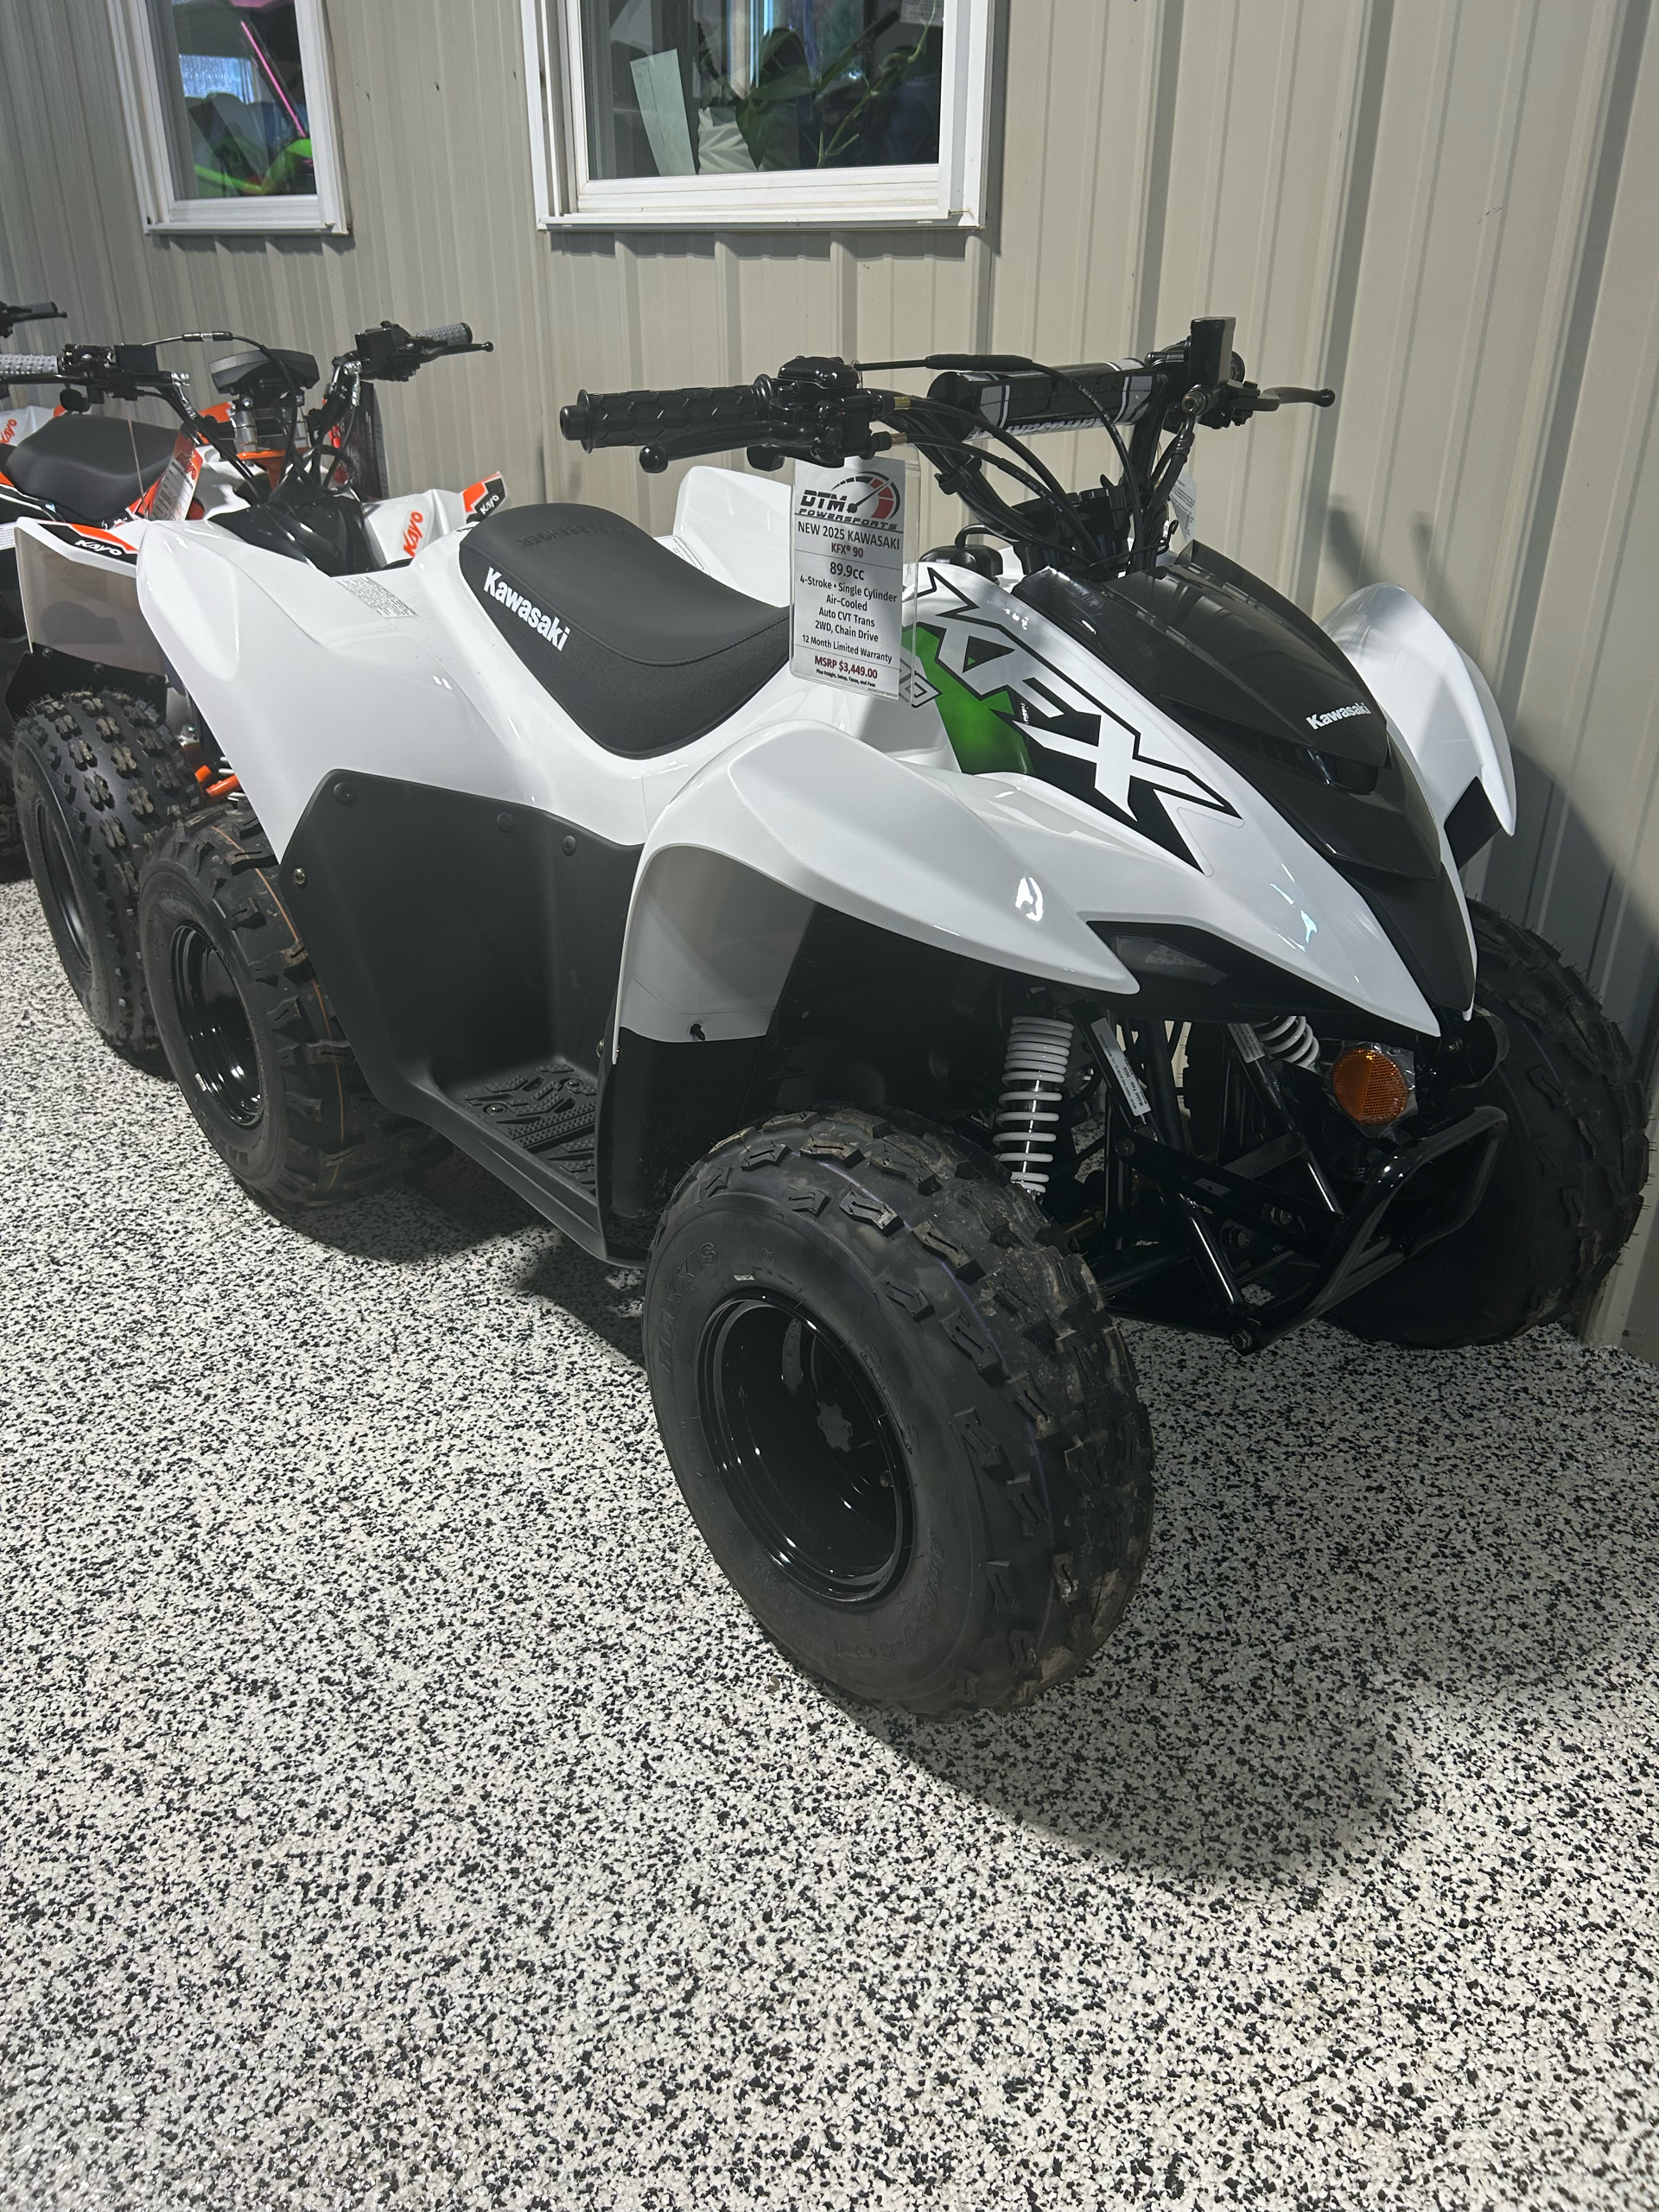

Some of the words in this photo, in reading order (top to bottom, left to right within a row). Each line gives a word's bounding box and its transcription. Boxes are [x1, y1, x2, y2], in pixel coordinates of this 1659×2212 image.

[800, 489, 847, 512] DTM
[798, 508, 899, 530] POWERSPORTS
[798, 521, 821, 536] NEW
[822, 524, 845, 540] 2025
[848, 528, 899, 550] KAWASAKI
[852, 543, 864, 558] 90
[830, 561, 865, 581] 89.9cc
[799, 575, 832, 590] 4-Stroke
[838, 582, 862, 597] Single
[864, 587, 898, 603] Cylinder
[483, 567, 571, 652] Kawasaki
[826, 594, 868, 612] Air-Cooled
[818, 607, 836, 620] Auto
[837, 610, 852, 623] CVT
[853, 613, 875, 627] Trans
[815, 620, 834, 634] 2WD,
[835, 624, 856, 638] Chain
[858, 628, 879, 642] Drive
[802, 634, 810, 643] 12
[810, 635, 832, 649] Month
[833, 639, 859, 655] Limited
[860, 646, 893, 664] Warranty
[814, 655, 837, 670] MSRP
[838, 658, 878, 679] $3,449.00
[1306, 702, 1371, 730] Kawasaki
